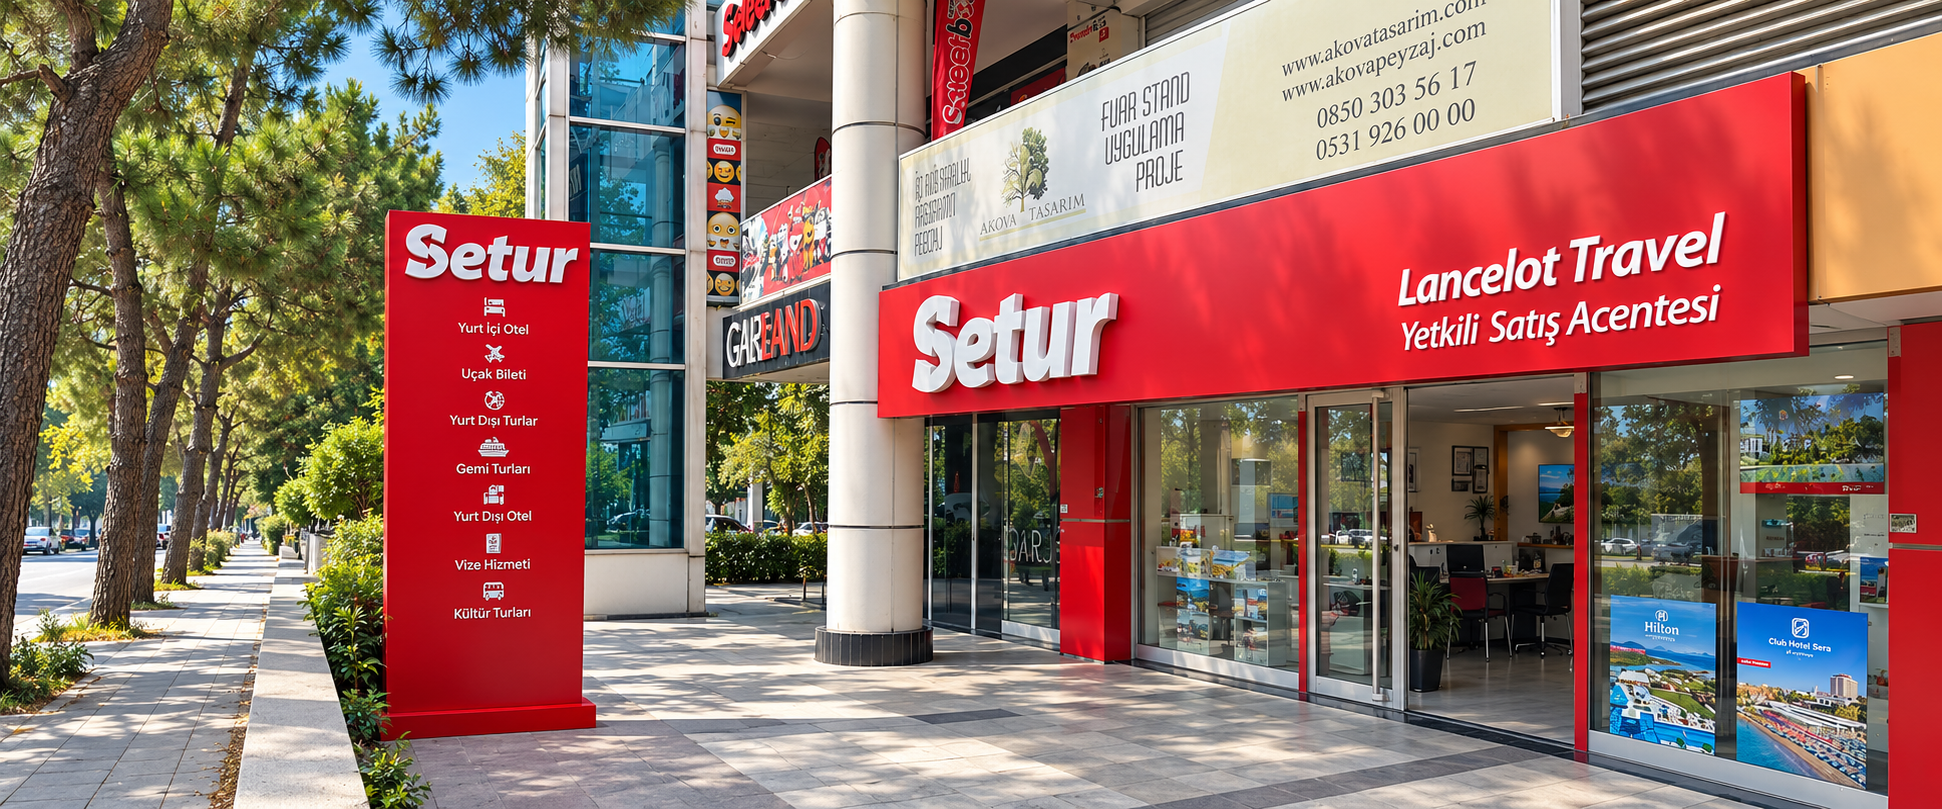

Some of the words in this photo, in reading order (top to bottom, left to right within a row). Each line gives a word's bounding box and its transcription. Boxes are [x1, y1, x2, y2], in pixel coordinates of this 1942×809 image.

[1281, 0, 1487, 77] www.akovatasarim.com
[1281, 21, 1487, 102] www.akovapeyzaj.com
[1100, 94, 1138, 132] FUAR
[1142, 71, 1190, 117] STAND
[1316, 96, 1363, 129] 0850
[1369, 83, 1406, 115] 303
[1414, 72, 1441, 102] 56
[1449, 60, 1478, 91] 17
[1105, 112, 1185, 166] UYGULAMA
[1315, 130, 1361, 161] 0531
[1368, 116, 1407, 148] 926
[1413, 108, 1440, 135] 00
[1447, 98, 1476, 126] 00
[1135, 149, 1184, 193] PROJE
[979, 214, 1018, 236] AKOVA
[1028, 193, 1086, 221] TASARIM
[404, 223, 579, 284] Setur
[1398, 246, 1561, 307] Lancelot
[1569, 211, 1727, 284] Travel
[457, 322, 484, 334] Yurt
[486, 321, 501, 336] İçi
[503, 323, 529, 335] Otel
[1400, 313, 1482, 351] Yetkili
[1489, 310, 1561, 346] Satış
[1566, 284, 1723, 336] Acentesi
[911, 292, 1120, 394] Setur
[461, 367, 493, 382] Uçak
[496, 368, 527, 380] Bileti
[449, 414, 476, 426] Yurt
[478, 414, 501, 428] Dışı
[503, 415, 539, 427] Turlar
[456, 462, 489, 475] Gemi
[491, 463, 531, 475] Turları
[453, 510, 480, 522] Yurt
[482, 511, 504, 525] Dışı
[506, 510, 532, 522] Otel
[454, 559, 482, 571] Vize
[484, 558, 531, 570] Hizmeti
[454, 607, 491, 620] Kültür
[493, 607, 531, 618] Turları
[1644, 621, 1680, 636] Hilton
[1768, 637, 1787, 647] Club
[1789, 640, 1811, 650] Hotel
[1812, 643, 1832, 653] Sera
